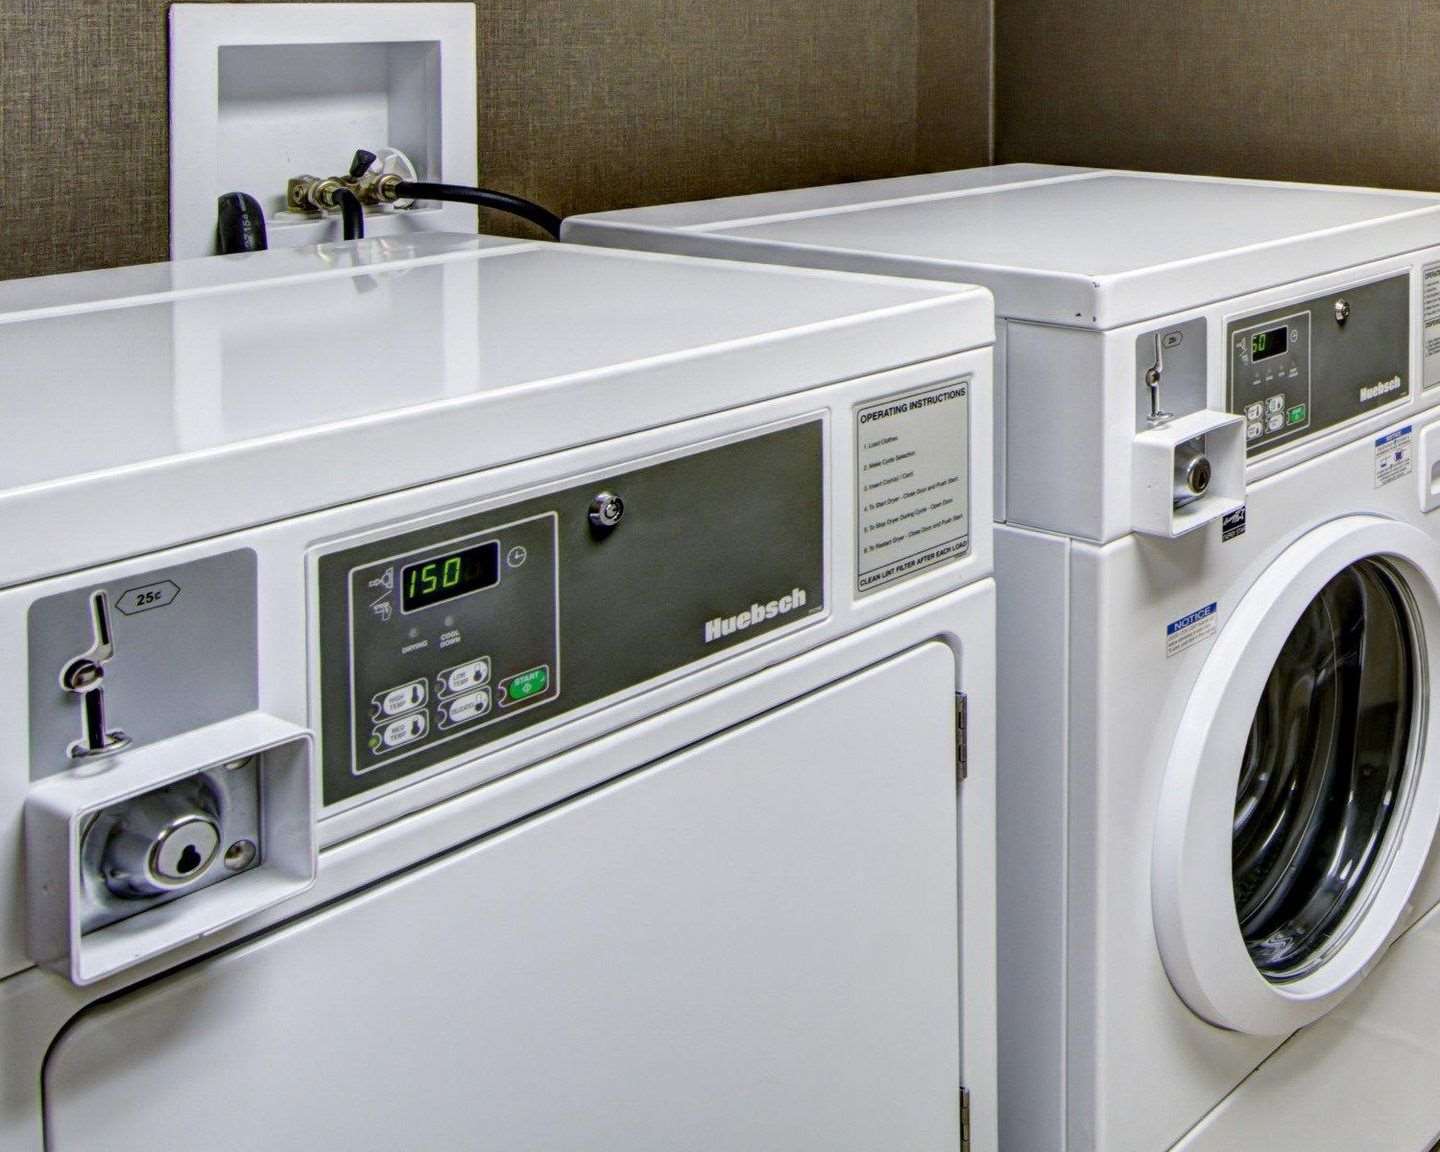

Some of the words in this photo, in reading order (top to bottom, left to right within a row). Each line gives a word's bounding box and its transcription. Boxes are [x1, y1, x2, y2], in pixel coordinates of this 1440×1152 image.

[860, 403, 908, 424] OPERATING
[909, 387, 966, 411] INSTRUCTIONS
[409, 557, 461, 598] 150
[860, 574, 881, 587] CLEAN
[896, 559, 916, 572] FILTER
[917, 552, 935, 565] AFTER
[936, 546, 952, 558] EACH
[952, 540, 968, 552] LOAD
[704, 587, 807, 644] Huebsch
[1174, 607, 1211, 630] NOTICE
